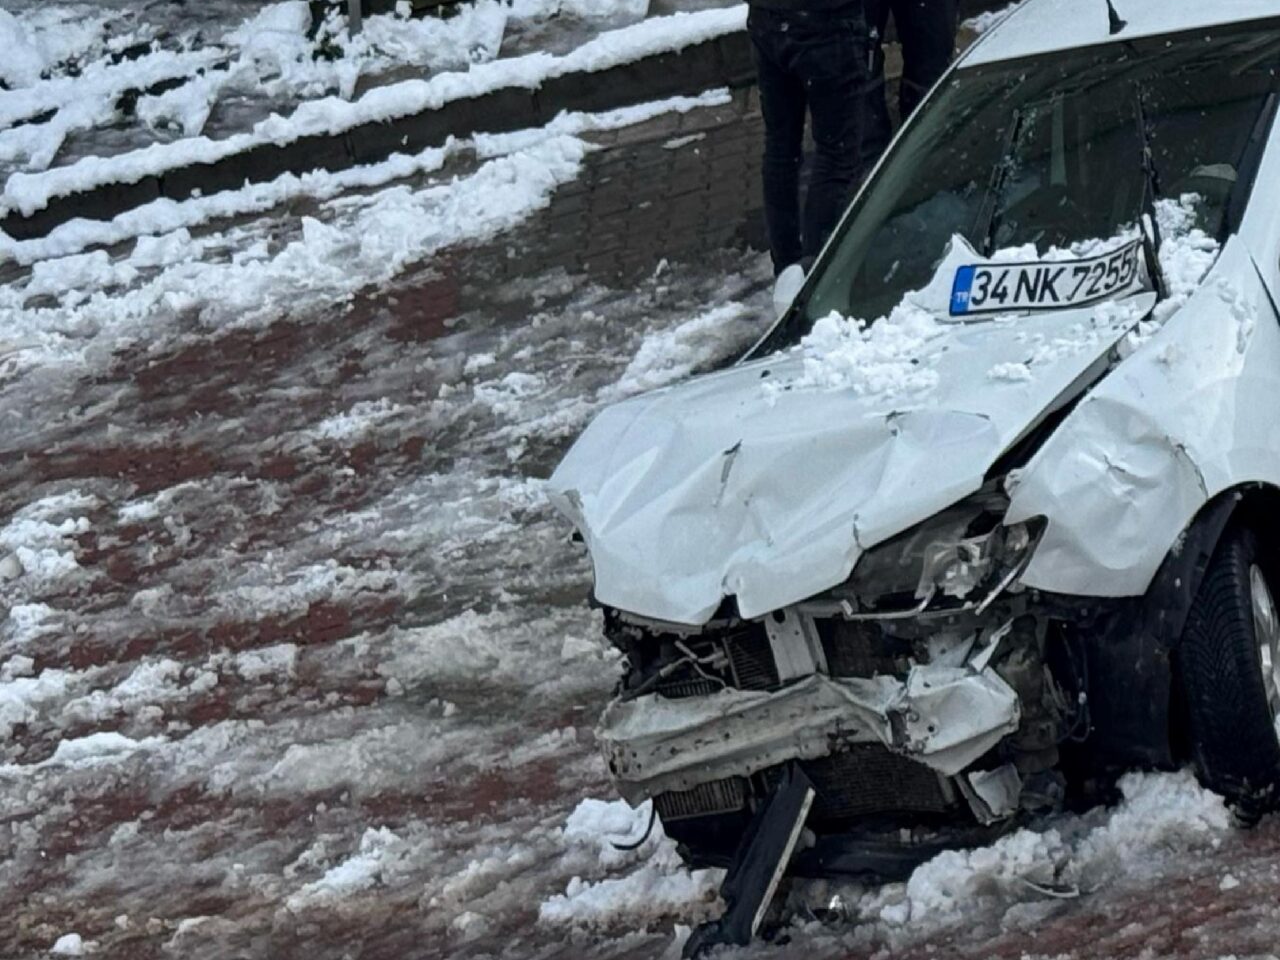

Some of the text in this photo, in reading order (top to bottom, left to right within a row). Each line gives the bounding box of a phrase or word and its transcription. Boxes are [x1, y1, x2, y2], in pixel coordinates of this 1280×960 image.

[971, 248, 1135, 306] 34 NK 7255
